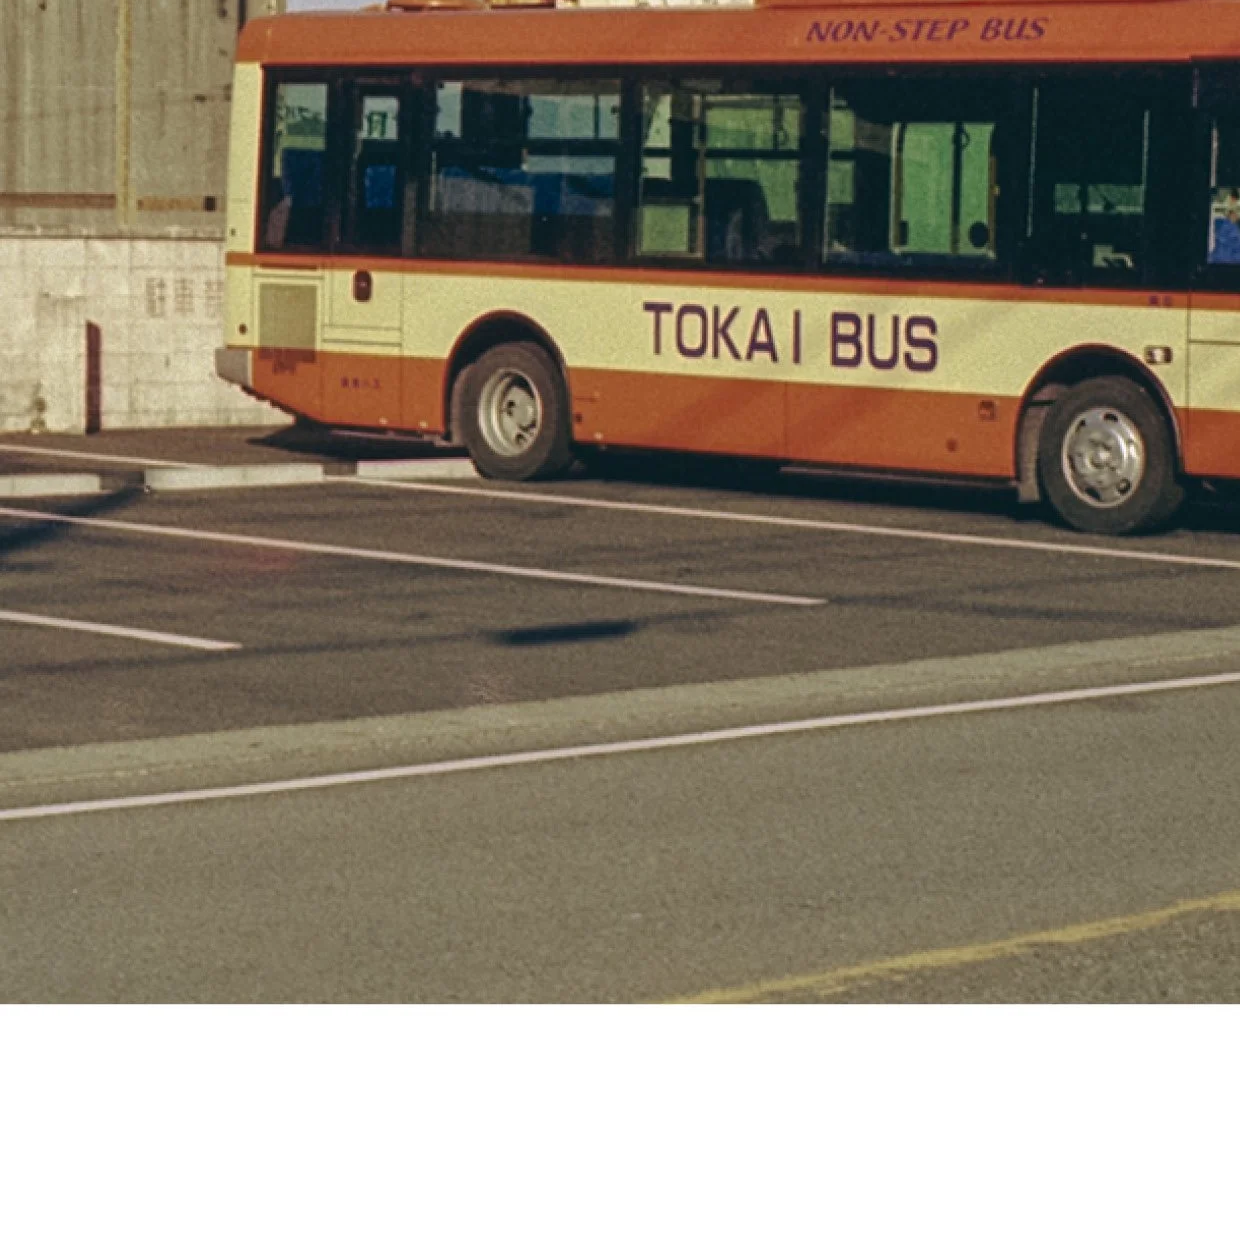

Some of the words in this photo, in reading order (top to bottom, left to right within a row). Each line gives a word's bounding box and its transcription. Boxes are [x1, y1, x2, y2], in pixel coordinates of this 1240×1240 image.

[806, 18, 970, 42] NON-STEP
[980, 16, 1050, 41] BUS
[831, 311, 938, 373] BUS
